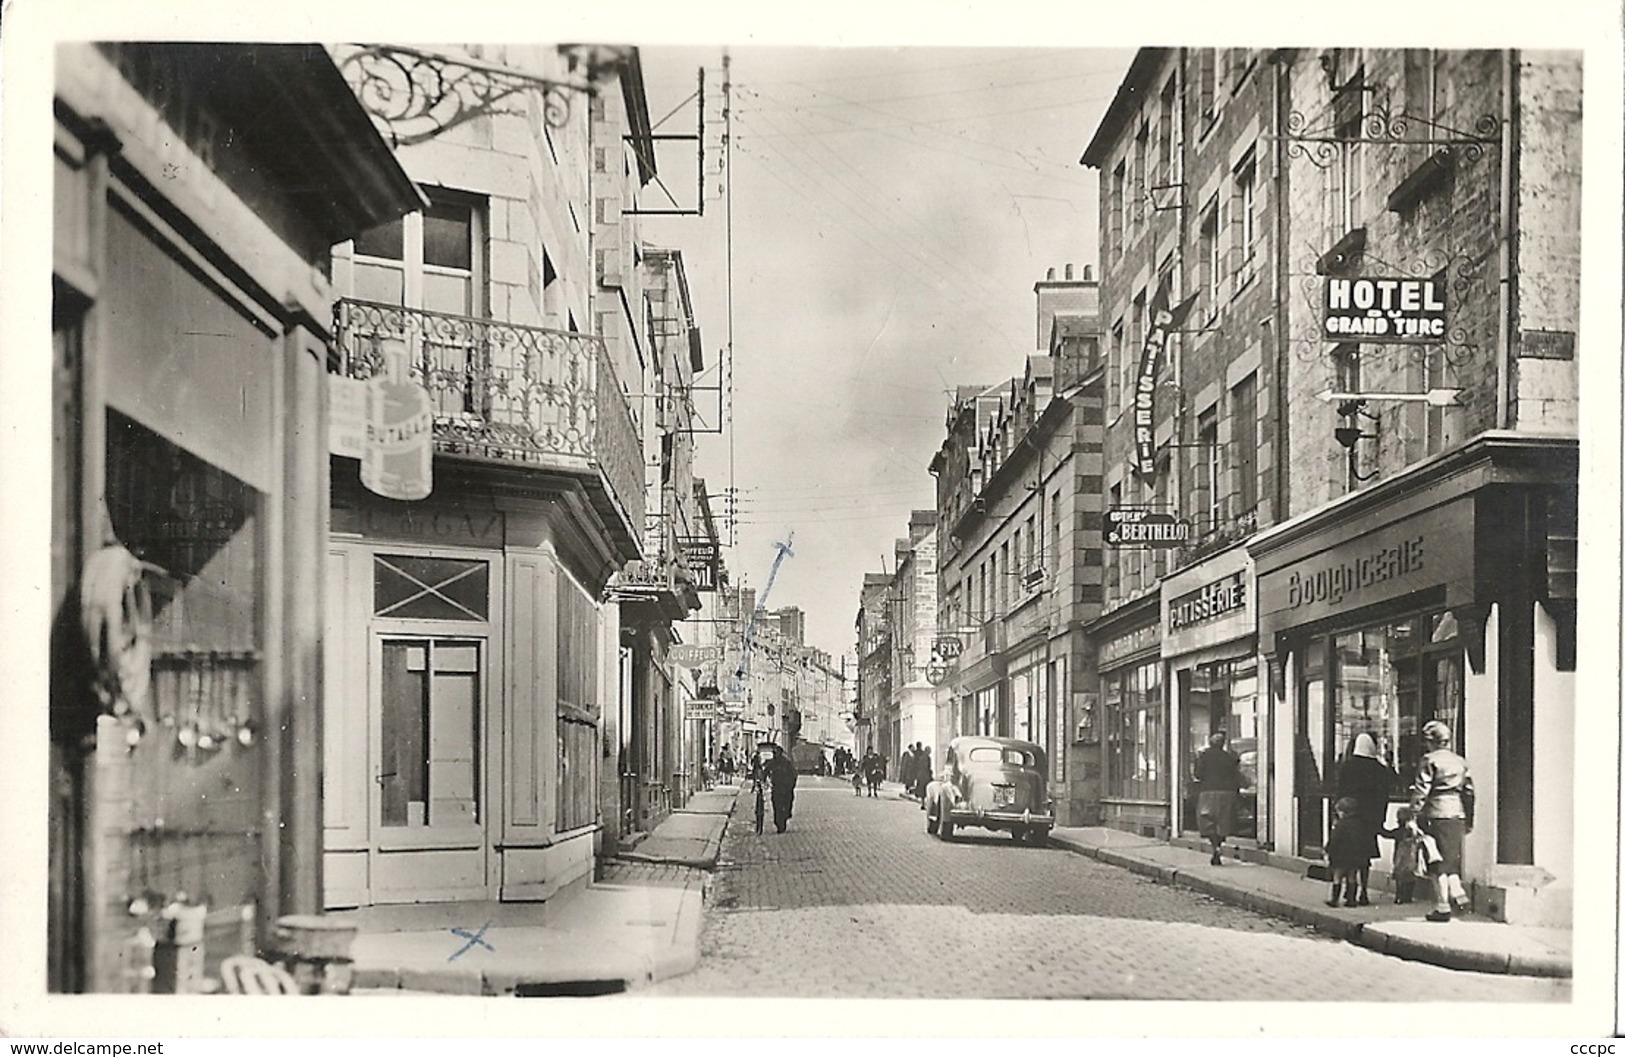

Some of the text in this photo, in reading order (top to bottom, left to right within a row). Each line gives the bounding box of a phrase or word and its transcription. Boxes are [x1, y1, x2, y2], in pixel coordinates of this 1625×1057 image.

[1328, 279, 1444, 311] HOTEL
[1325, 315, 1444, 335] GRAND TURC
[1366, 308, 1402, 319] DU
[1136, 309, 1173, 474] PATISSERIE
[1288, 534, 1424, 612] BOULANGERIE
[1169, 583, 1240, 629] PATISSERIE
[670, 648, 717, 662] COIFFEUR
[939, 642, 961, 656] FIX
